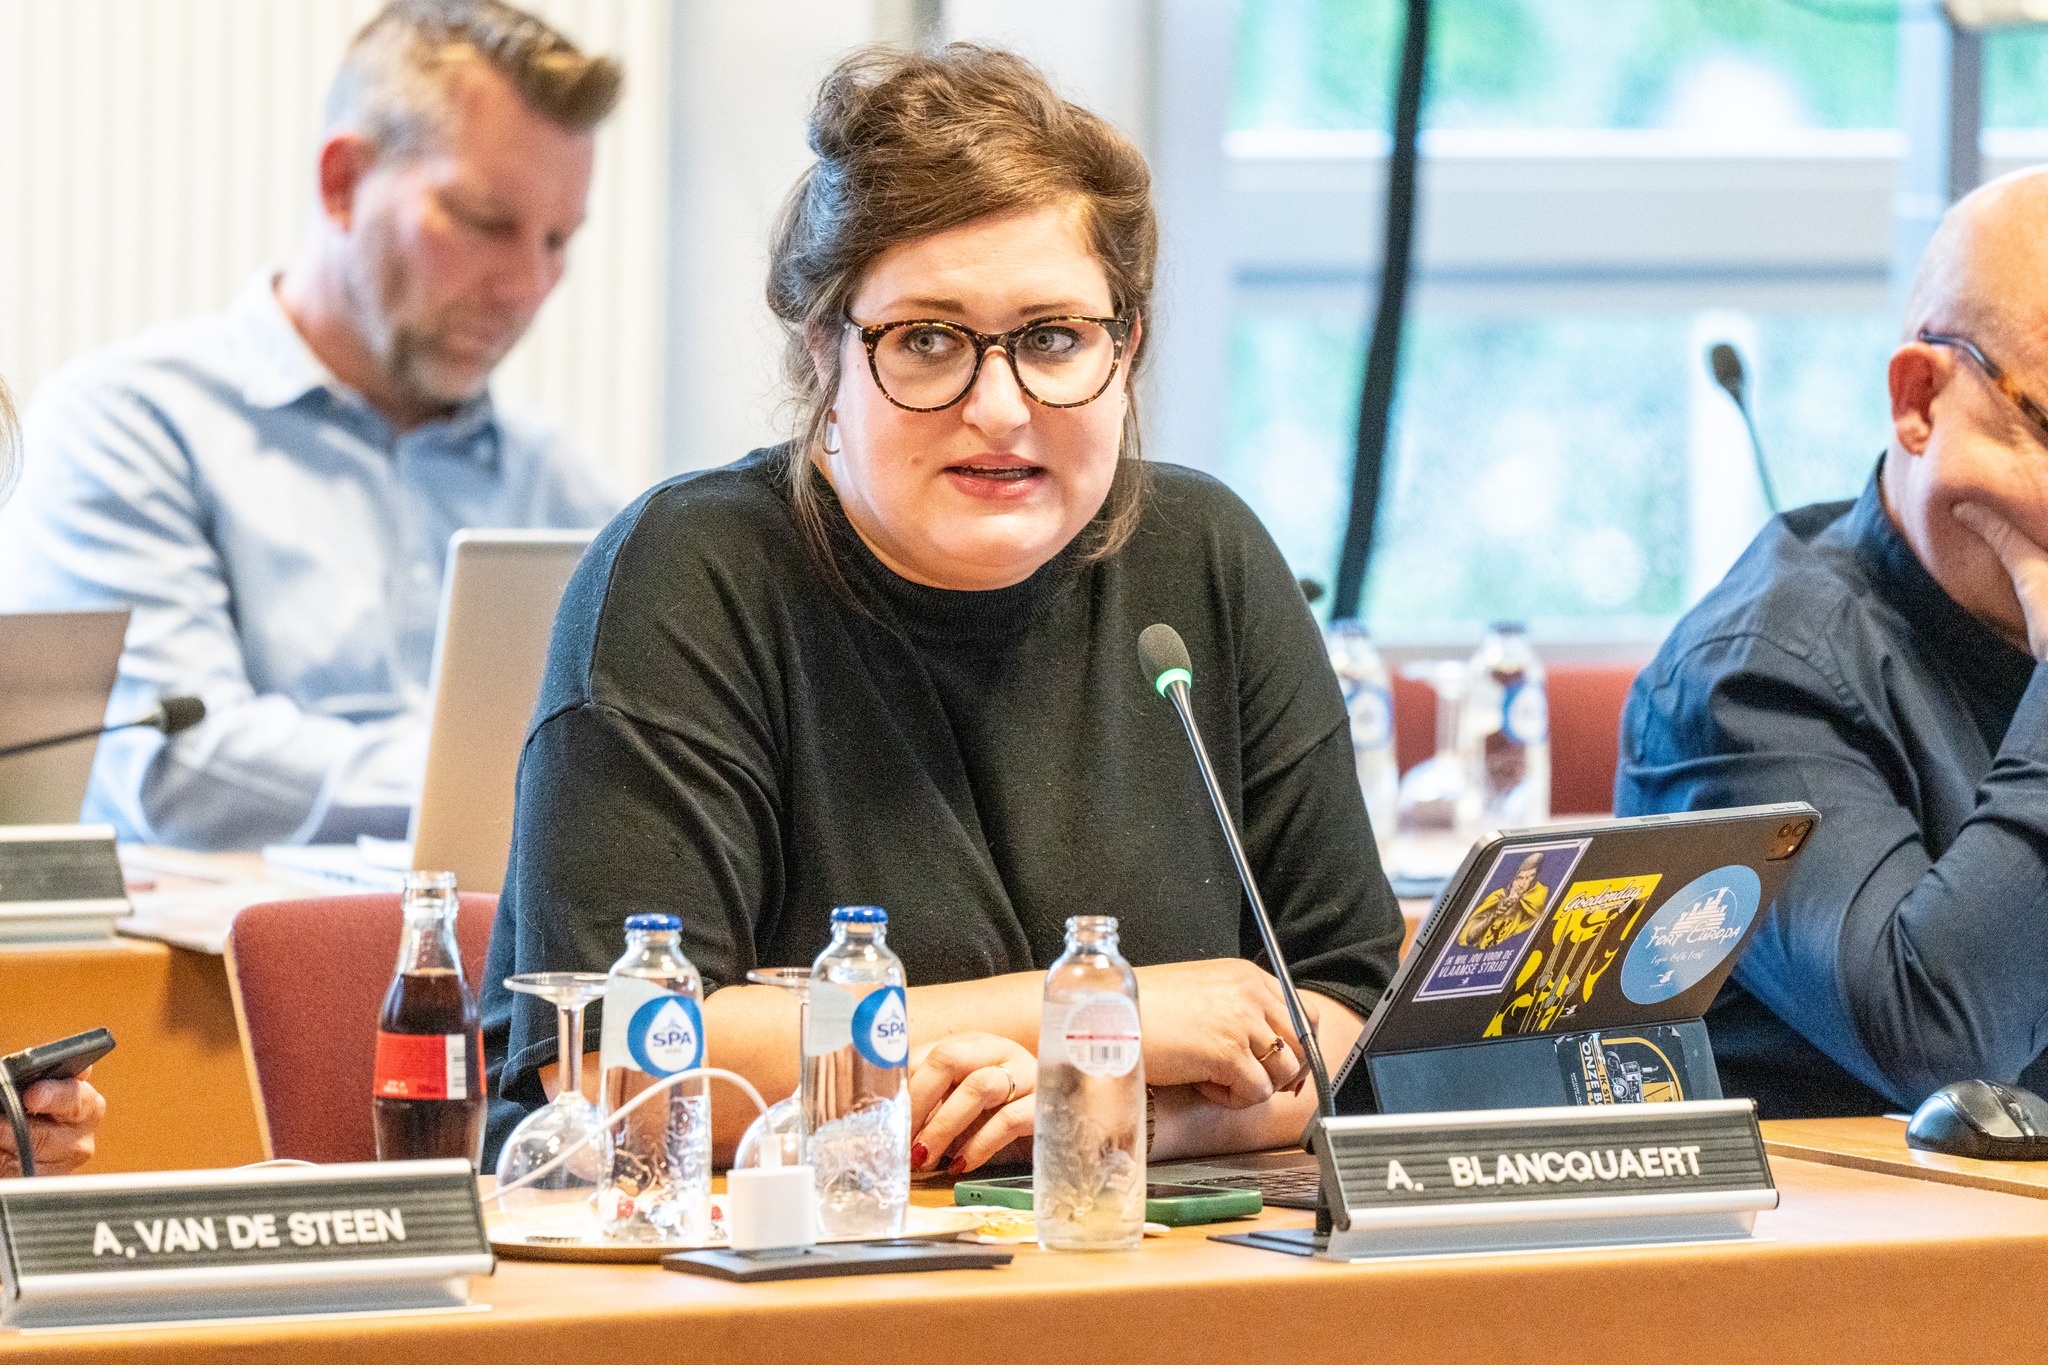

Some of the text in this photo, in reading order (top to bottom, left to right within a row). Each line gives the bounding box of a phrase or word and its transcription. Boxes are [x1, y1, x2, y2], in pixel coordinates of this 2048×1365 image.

[1560, 880, 1644, 918] Goedendag
[1444, 955, 1456, 966] IK
[1454, 954, 1468, 965] WIL
[1482, 950, 1503, 962] VOOR
[1502, 949, 1515, 960] DE
[1438, 960, 1508, 978] VLAAMSE STRIJD
[877, 1021, 906, 1038] SPA
[653, 1031, 692, 1047] SPA
[1581, 1041, 1600, 1088] ONZE
[1600, 1074, 1608, 1085] IK
[1386, 1146, 1700, 1192] A. BLANCQUAERT
[134, 1216, 218, 1253] VAN
[227, 1213, 280, 1249] DE
[288, 1208, 406, 1246] STEEN
